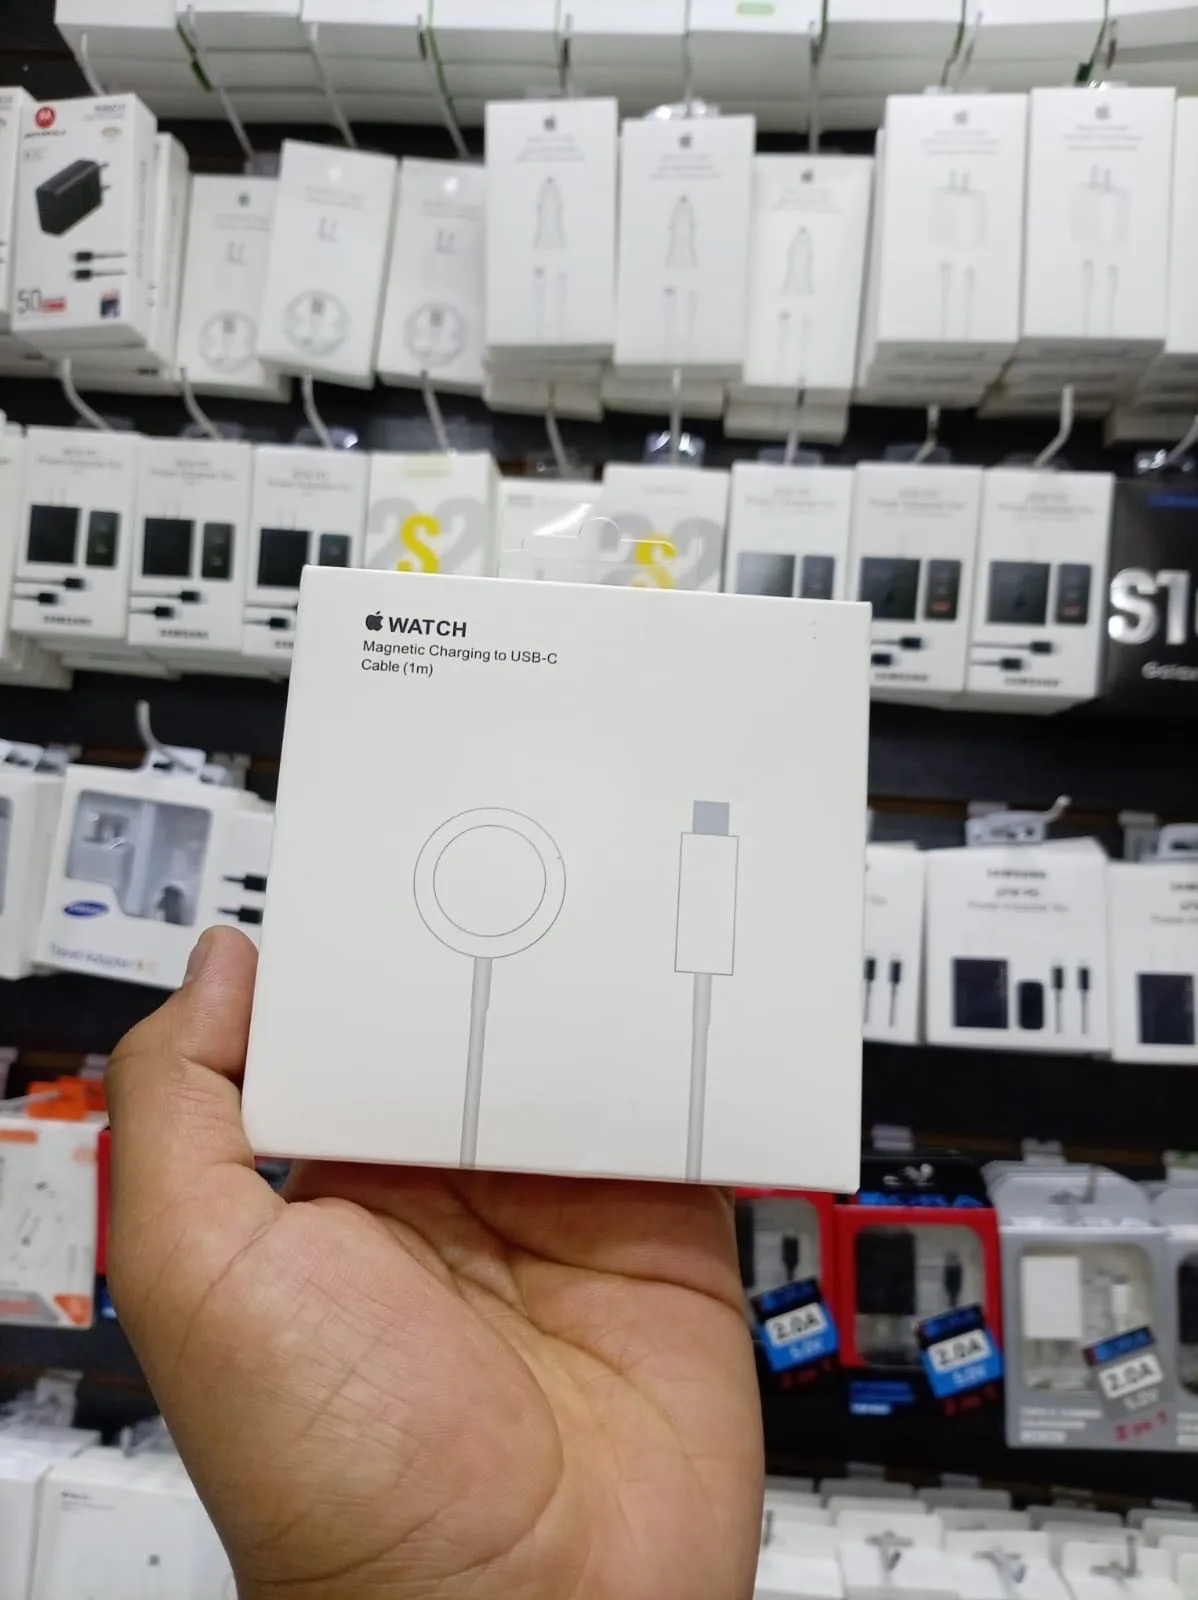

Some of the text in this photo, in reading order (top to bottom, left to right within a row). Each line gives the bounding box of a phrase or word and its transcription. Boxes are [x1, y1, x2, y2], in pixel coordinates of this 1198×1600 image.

[1107, 566, 1198, 645] S1
[388, 616, 468, 638] WATCH
[362, 640, 558, 665] Magnetic Charging to USB-C
[361, 658, 434, 678] Cable (1m)
